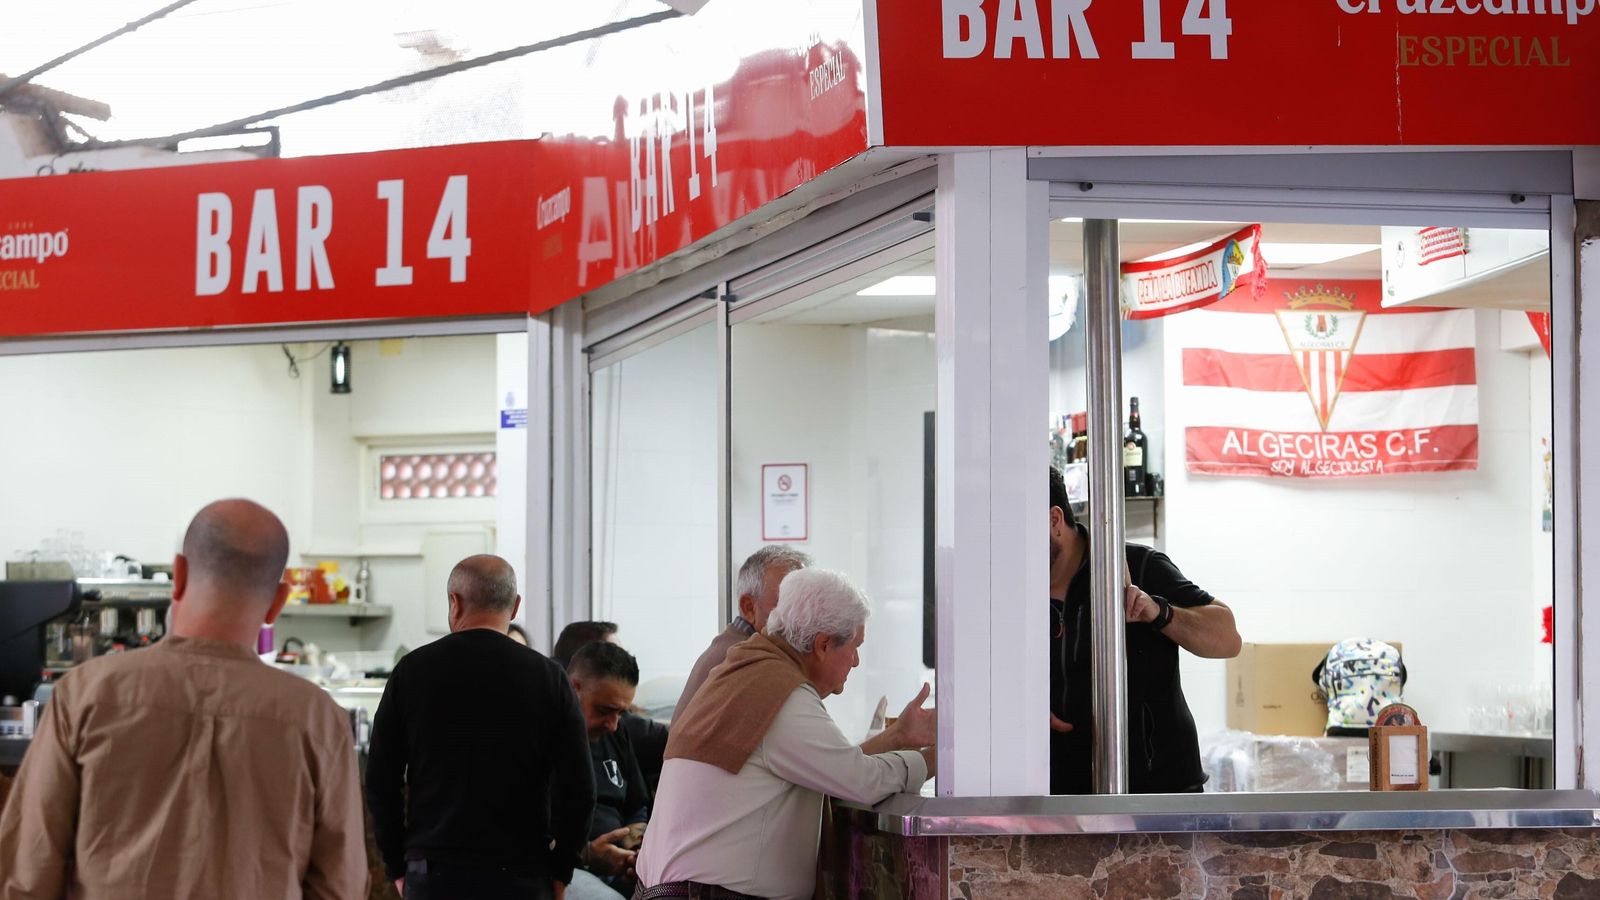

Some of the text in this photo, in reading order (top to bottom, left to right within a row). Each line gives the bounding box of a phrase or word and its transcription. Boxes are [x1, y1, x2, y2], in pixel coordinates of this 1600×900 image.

[942, 0, 1233, 60] BAR 14
[1399, 35, 1571, 67] ESPECIAL
[809, 50, 846, 101] ESPECIAL
[0, 228, 69, 264] ampo
[195, 185, 336, 296] BAR
[375, 174, 472, 287] 14
[1222, 429, 1439, 459] ALGECIRAS C.F.
[1270, 460, 1295, 476] SOY
